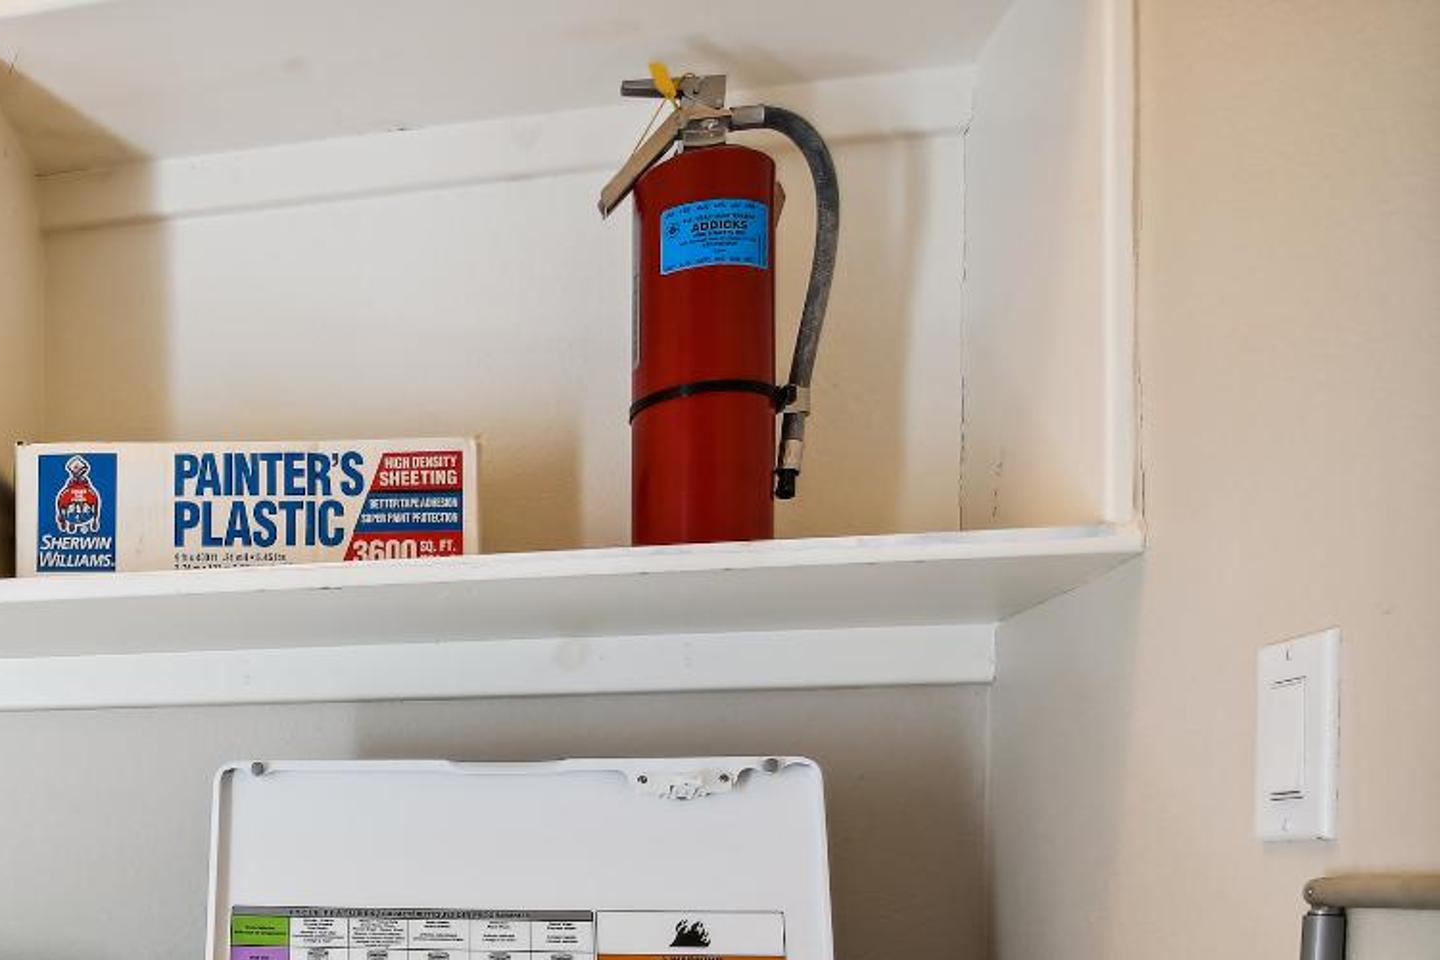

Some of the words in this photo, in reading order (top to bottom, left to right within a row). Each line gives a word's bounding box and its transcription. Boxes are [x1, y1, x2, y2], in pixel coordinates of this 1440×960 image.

[691, 219, 748, 233] ADDICKS
[385, 457, 410, 469] HIGH
[412, 455, 458, 468] DENSITY
[174, 451, 364, 497] PAINTER'S
[379, 470, 458, 486] SHEETING
[174, 499, 345, 548] PLASTIC
[40, 534, 112, 550] SHERWIN
[352, 539, 417, 561] 3600
